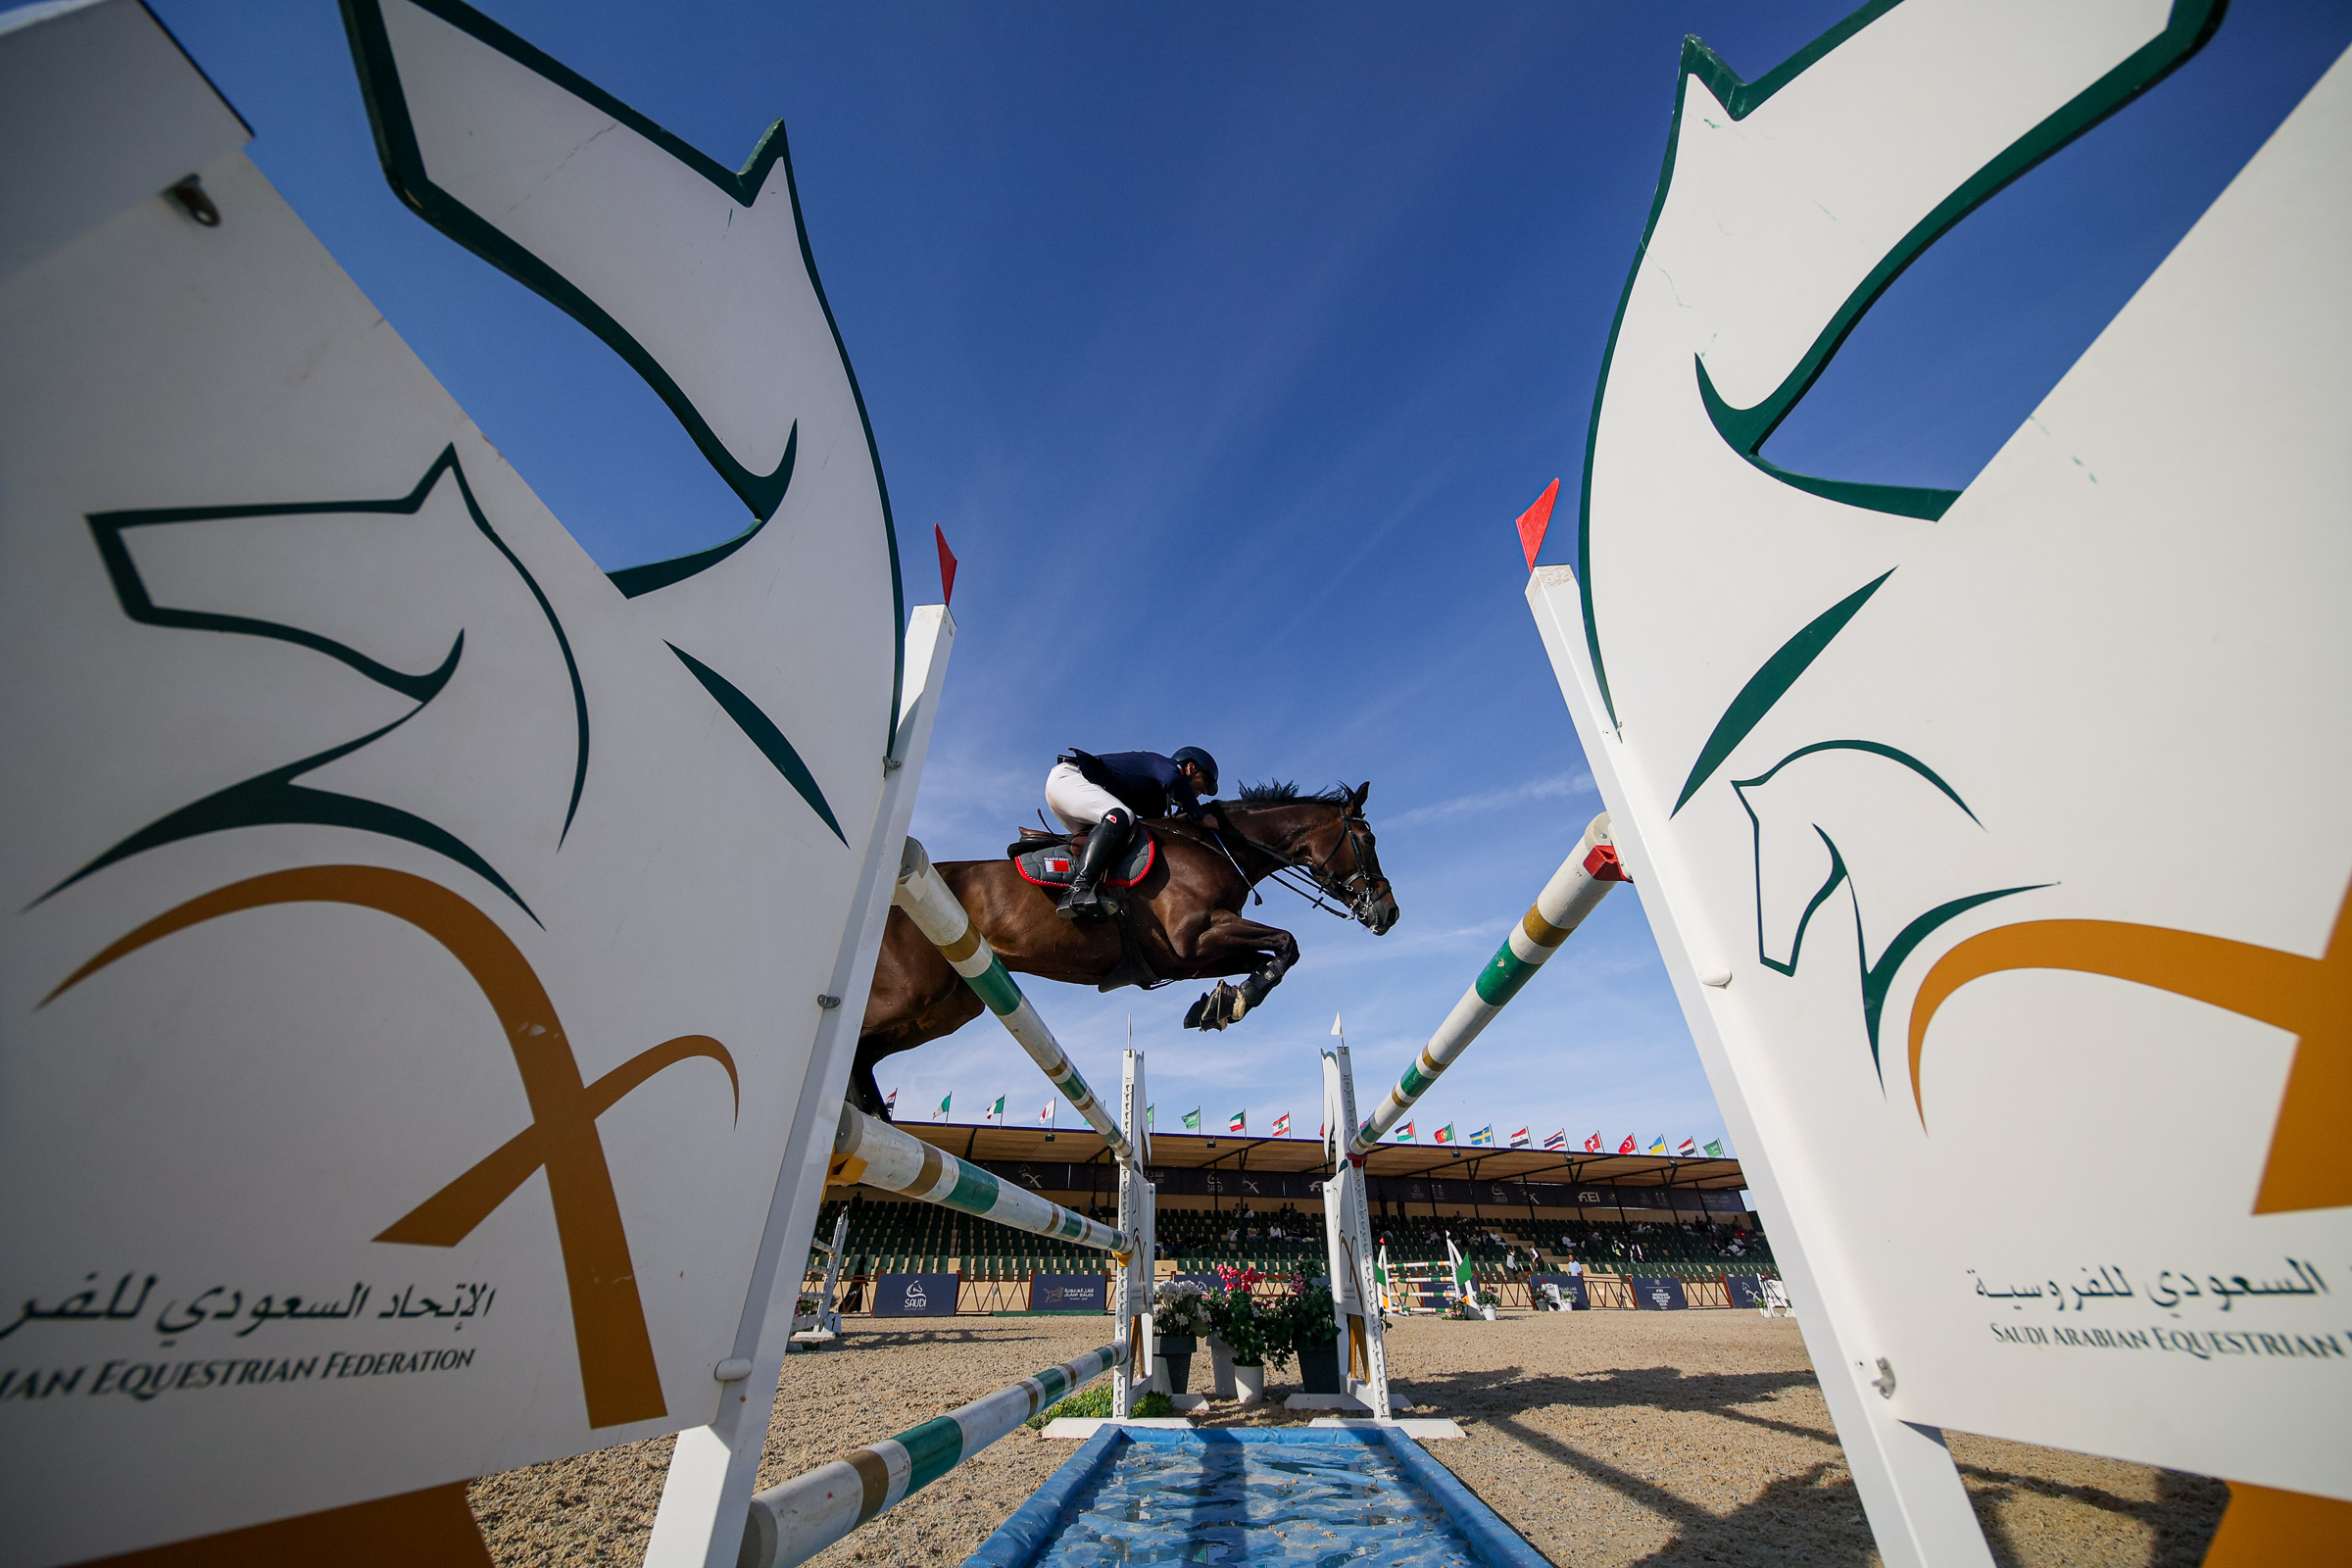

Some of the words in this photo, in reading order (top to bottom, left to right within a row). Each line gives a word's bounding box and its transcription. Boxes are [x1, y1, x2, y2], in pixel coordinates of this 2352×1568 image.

[1577, 1192, 1600, 1202] FEI
[1965, 1263, 2136, 1312] للفروسية
[2147, 1254, 2332, 1318] السعودي
[155, 1279, 372, 1348] السعودي
[904, 1298, 927, 1308] SAUDI
[831, 1316, 836, 1331] 1
